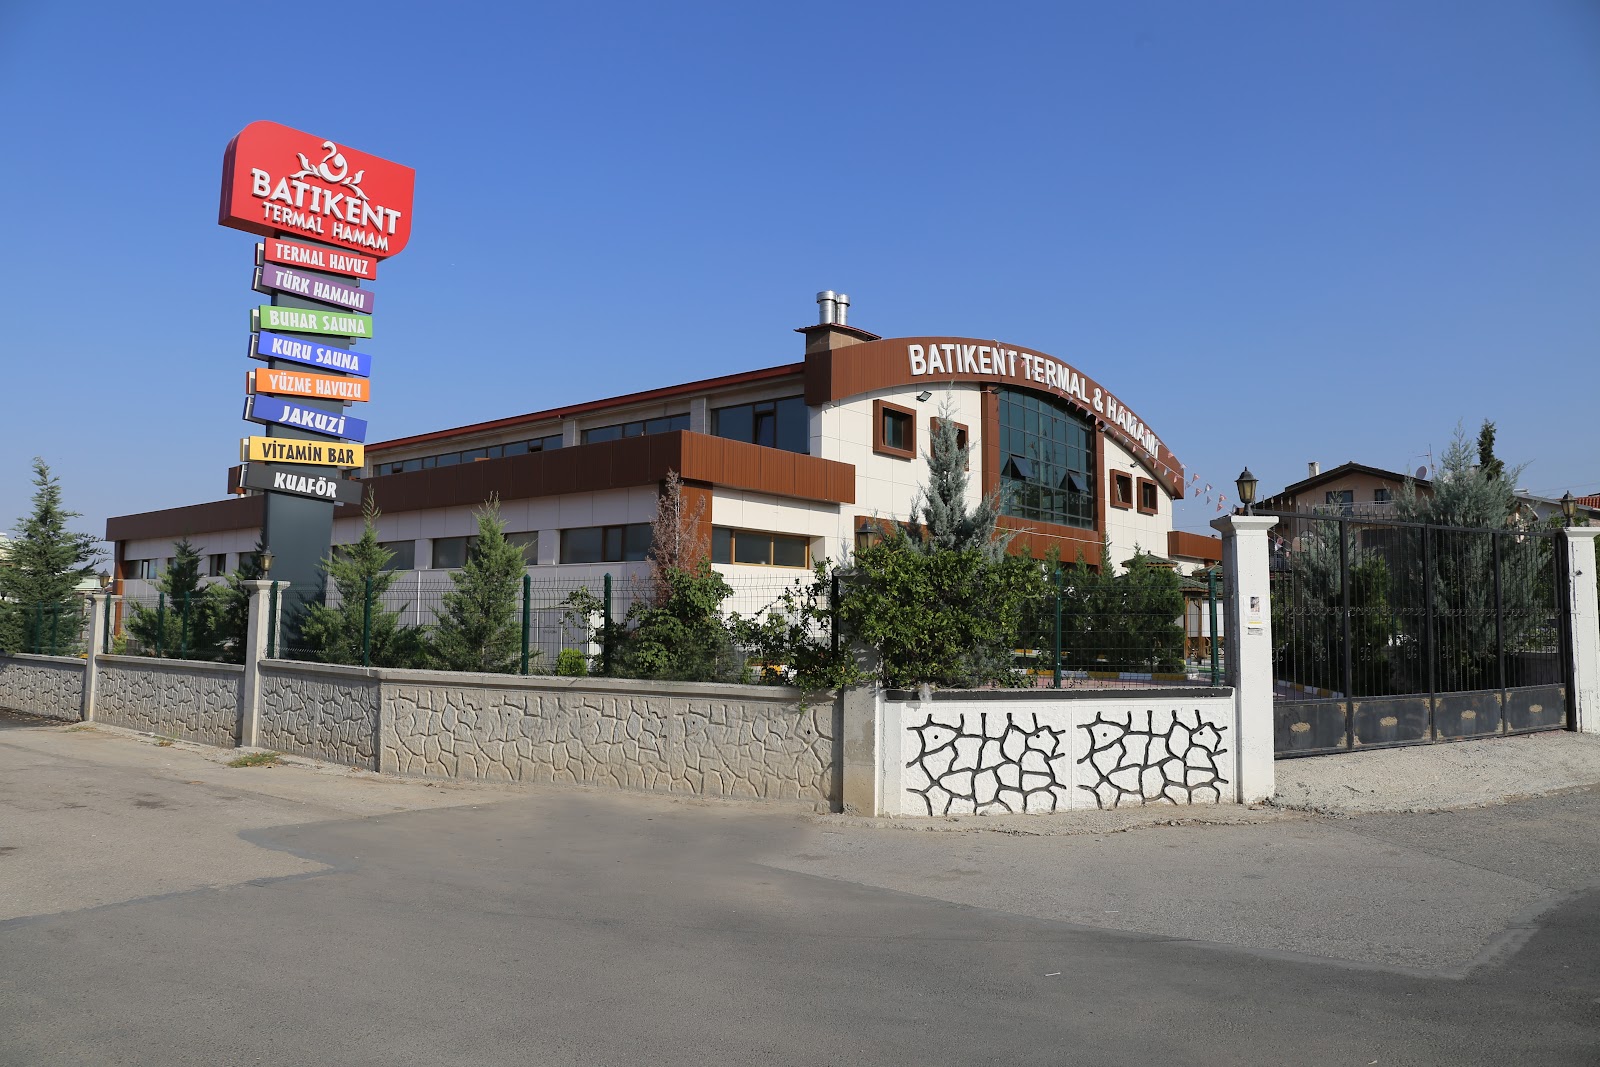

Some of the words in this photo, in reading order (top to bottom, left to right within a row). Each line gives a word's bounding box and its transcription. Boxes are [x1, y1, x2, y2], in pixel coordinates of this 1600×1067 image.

[251, 167, 401, 235] BATIKENT
[262, 201, 324, 234] TERMAL
[332, 221, 389, 252] HAMAM
[275, 243, 325, 267] TERMAL
[329, 254, 368, 275] HAVUZ
[275, 270, 310, 294] TÜRK
[313, 281, 365, 309] HAMAMI
[269, 310, 318, 330] BUHAR
[322, 315, 366, 334] SAUNA
[271, 337, 312, 360] KURU
[316, 347, 359, 371] SAUNA
[269, 372, 312, 394] YÜZME
[316, 379, 361, 399] HAVUZU
[908, 343, 1018, 377] BATIKENT
[1021, 352, 1091, 404] TERMAL
[1092, 387, 1104, 413] &
[1106, 395, 1159, 460] HAMAMI
[278, 405, 346, 435] JAKUZİ
[262, 440, 322, 461] VİTAMİN
[327, 447, 355, 465] BAR
[273, 472, 338, 498] KUAFÖR
